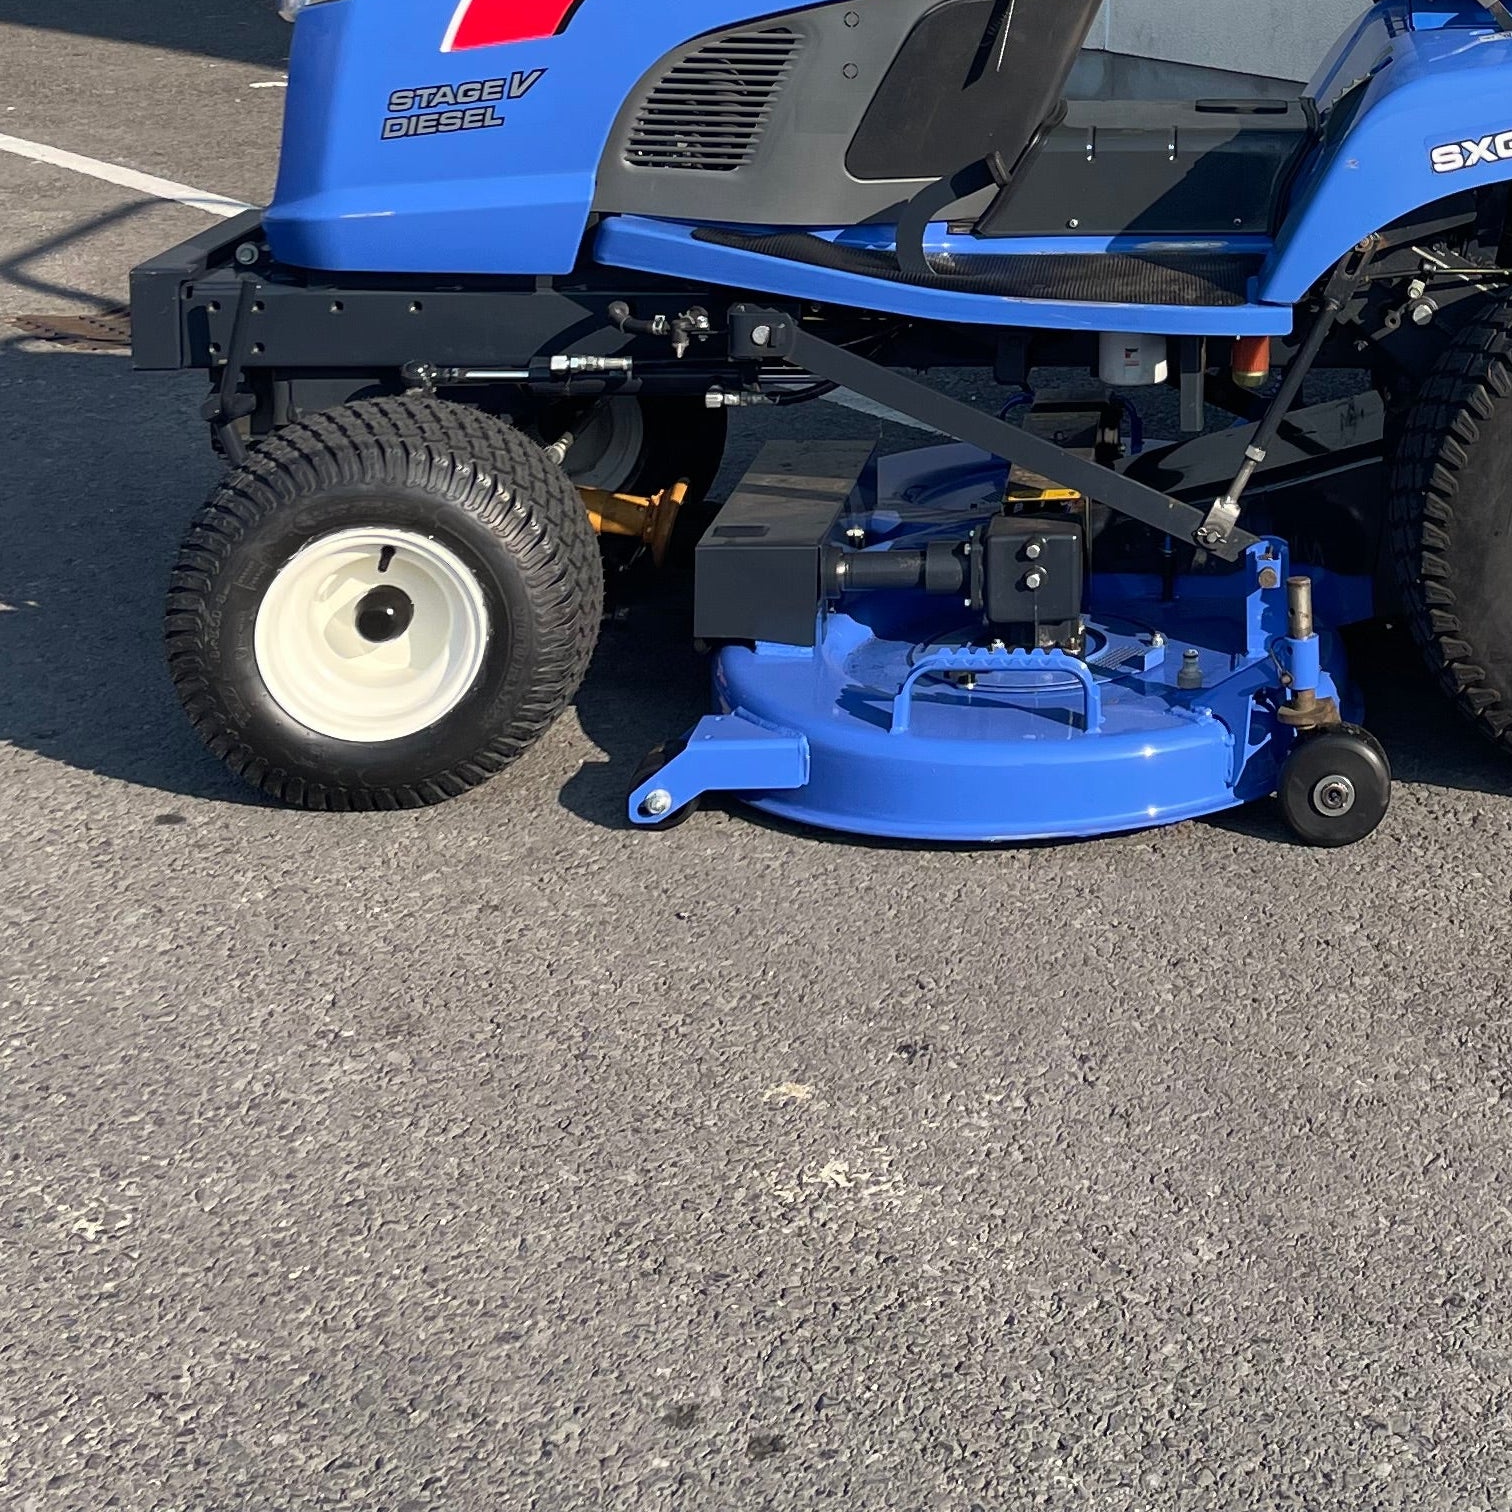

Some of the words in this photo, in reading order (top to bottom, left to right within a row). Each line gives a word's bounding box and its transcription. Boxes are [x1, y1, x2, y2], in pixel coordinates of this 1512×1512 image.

[387, 78, 507, 113] STAGE
[507, 68, 549, 99] V
[381, 105, 505, 140] DIESEL
